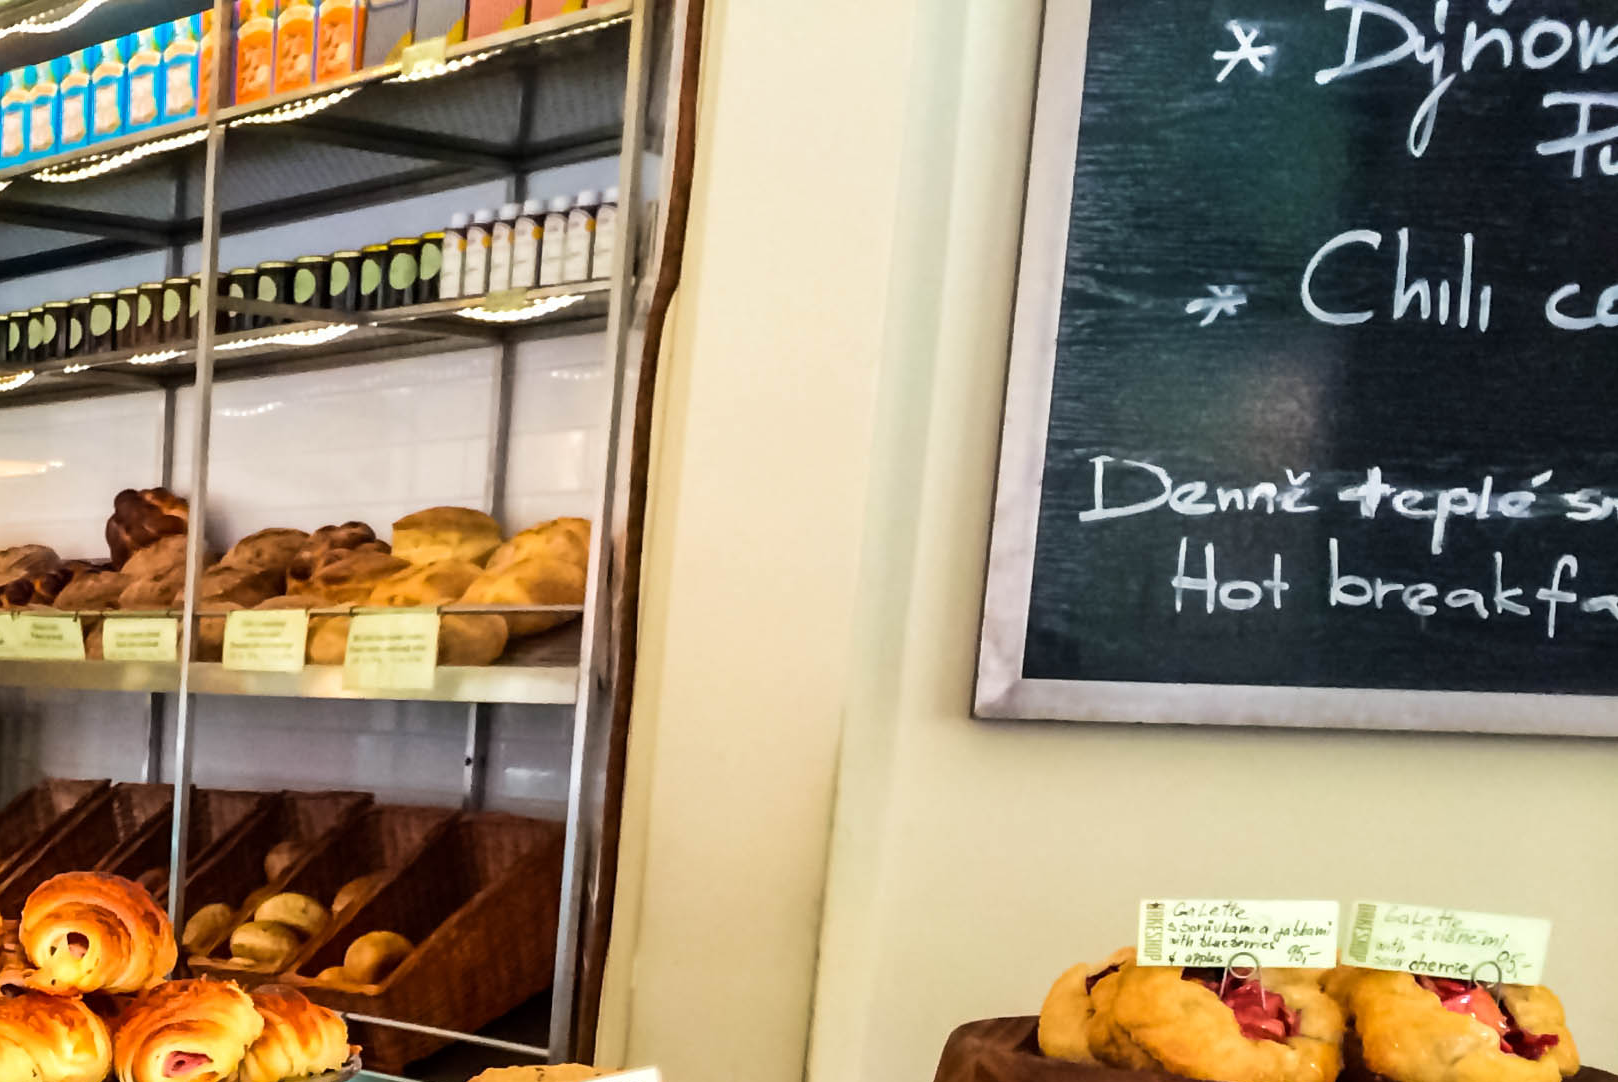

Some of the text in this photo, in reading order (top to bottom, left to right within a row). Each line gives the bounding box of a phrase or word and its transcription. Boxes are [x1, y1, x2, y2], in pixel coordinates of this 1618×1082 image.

[1300, 228, 1491, 333] Chili
[1338, 465, 1554, 555] teplé
[1171, 536, 1290, 615] Hot
